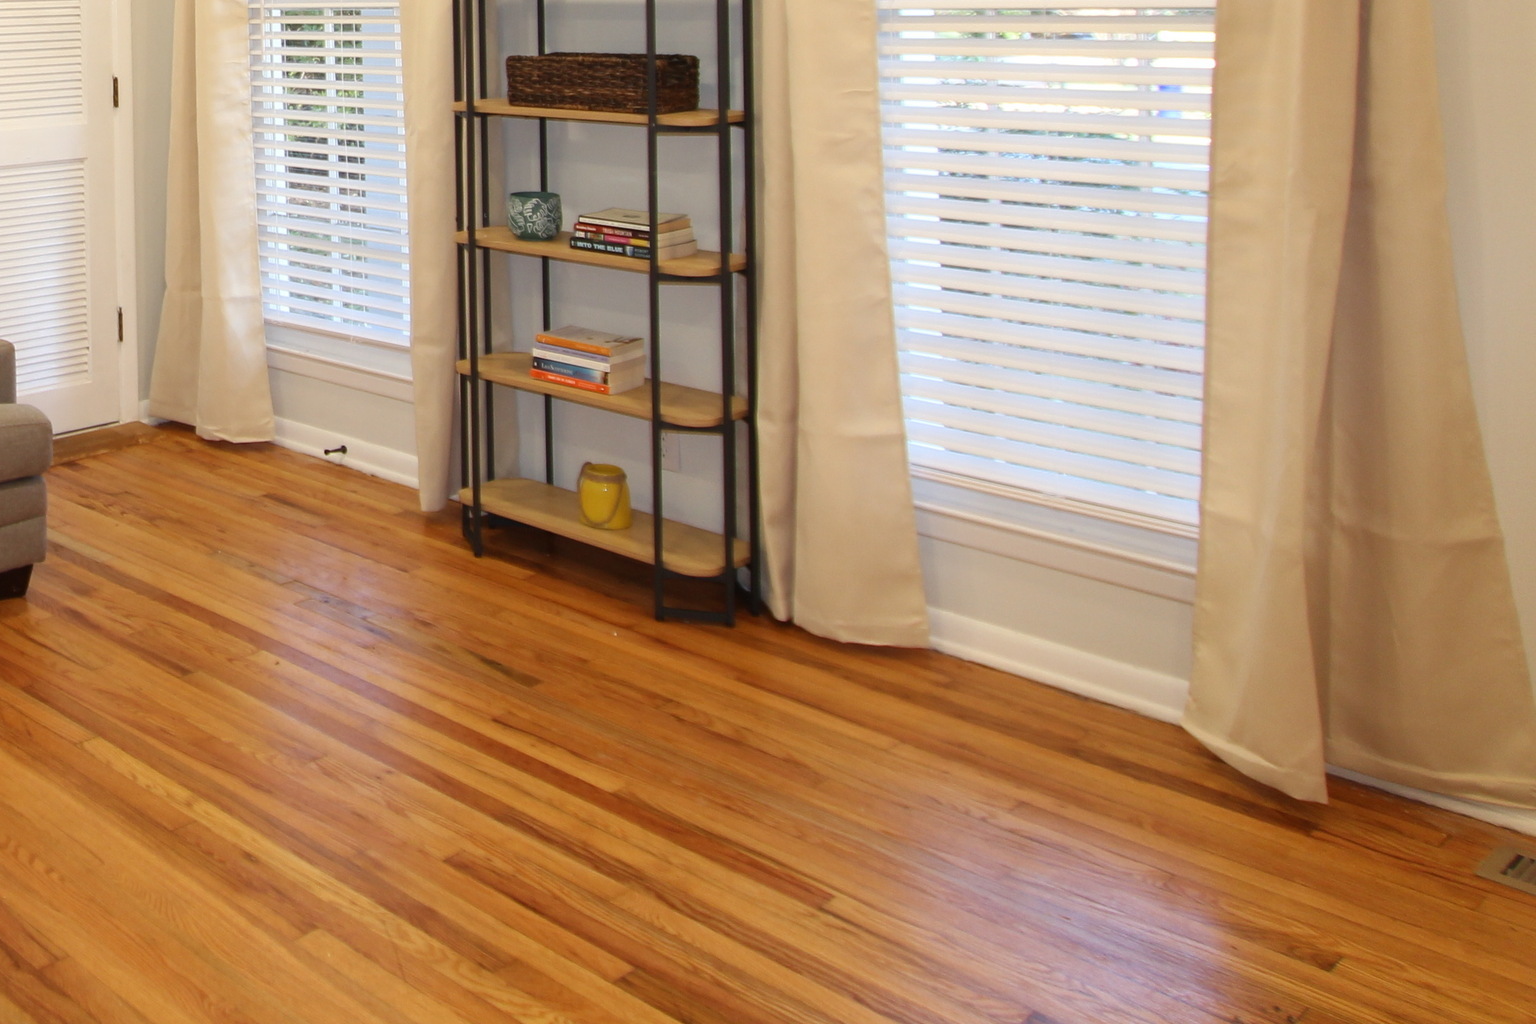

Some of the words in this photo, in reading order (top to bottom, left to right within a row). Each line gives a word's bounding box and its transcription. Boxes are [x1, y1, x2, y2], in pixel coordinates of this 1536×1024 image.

[576, 240, 592, 248] INTO
[593, 243, 606, 251] THE
[606, 245, 624, 254] BLUE
